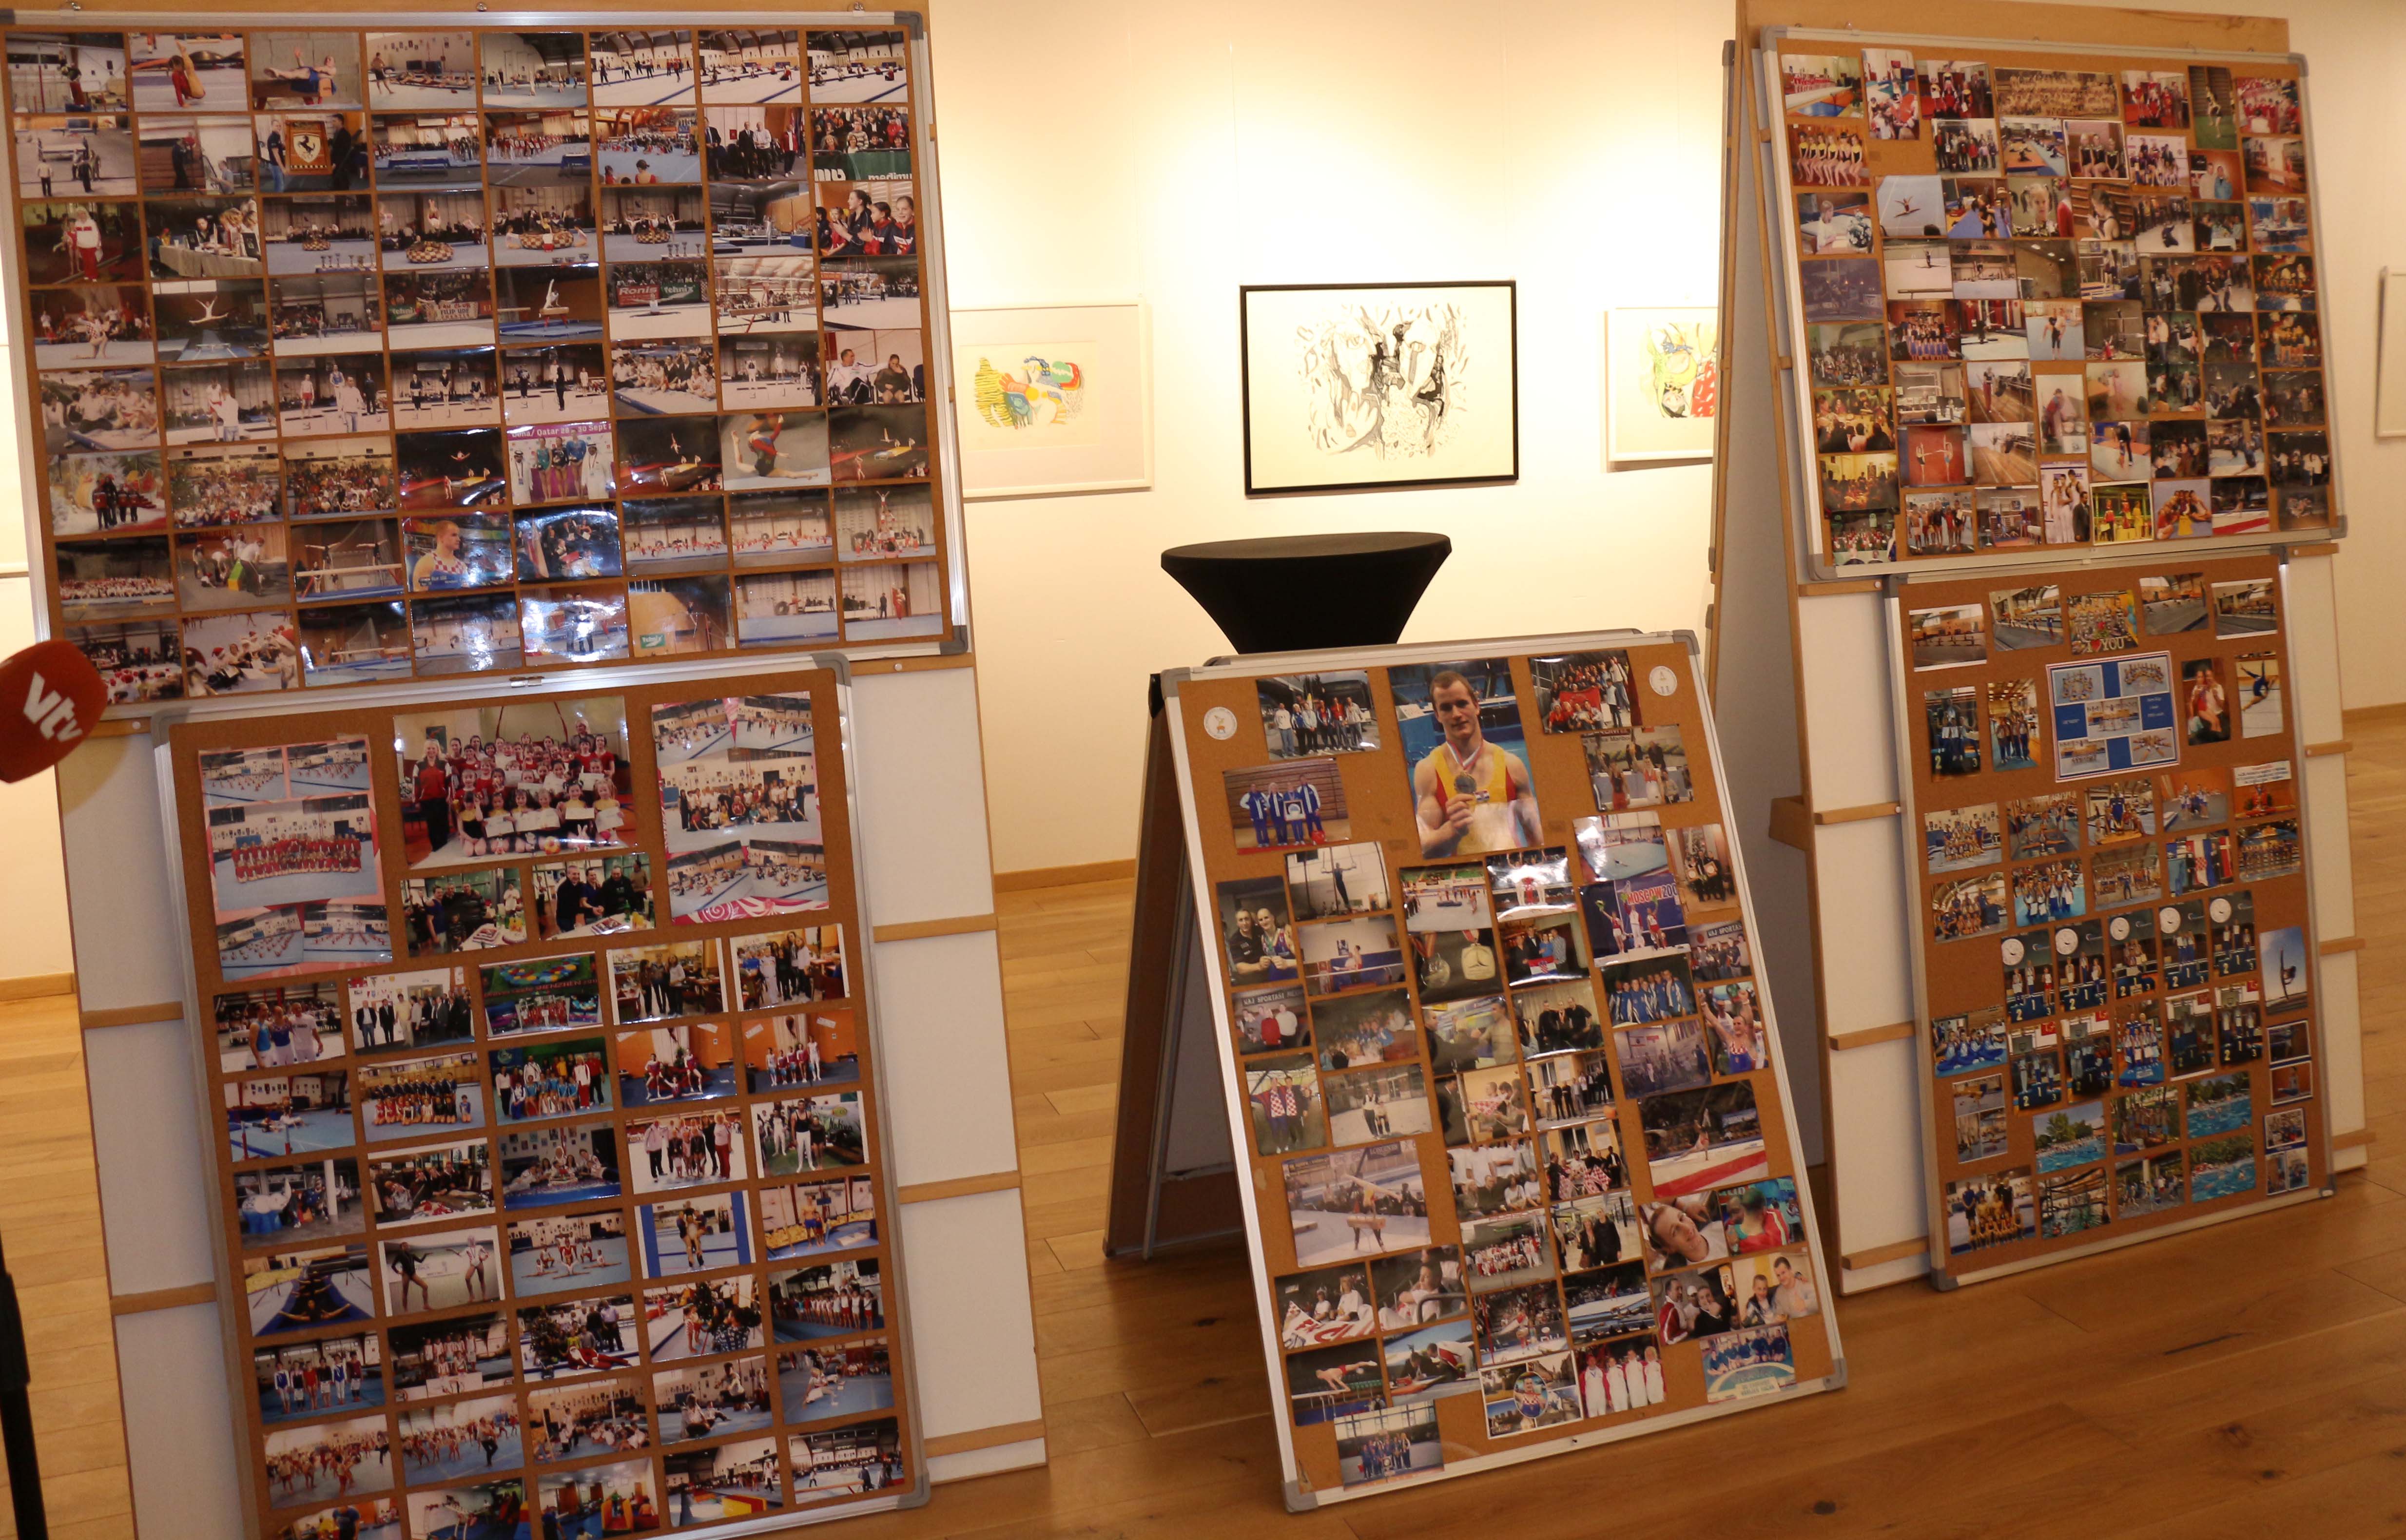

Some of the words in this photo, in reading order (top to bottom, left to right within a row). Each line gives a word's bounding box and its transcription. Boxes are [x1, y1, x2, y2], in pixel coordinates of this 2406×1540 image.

[619, 287, 657, 295] Ronis
[537, 428, 559, 437] Qatar
[589, 424, 607, 432] Sept
[2099, 638, 2124, 651] YOU
